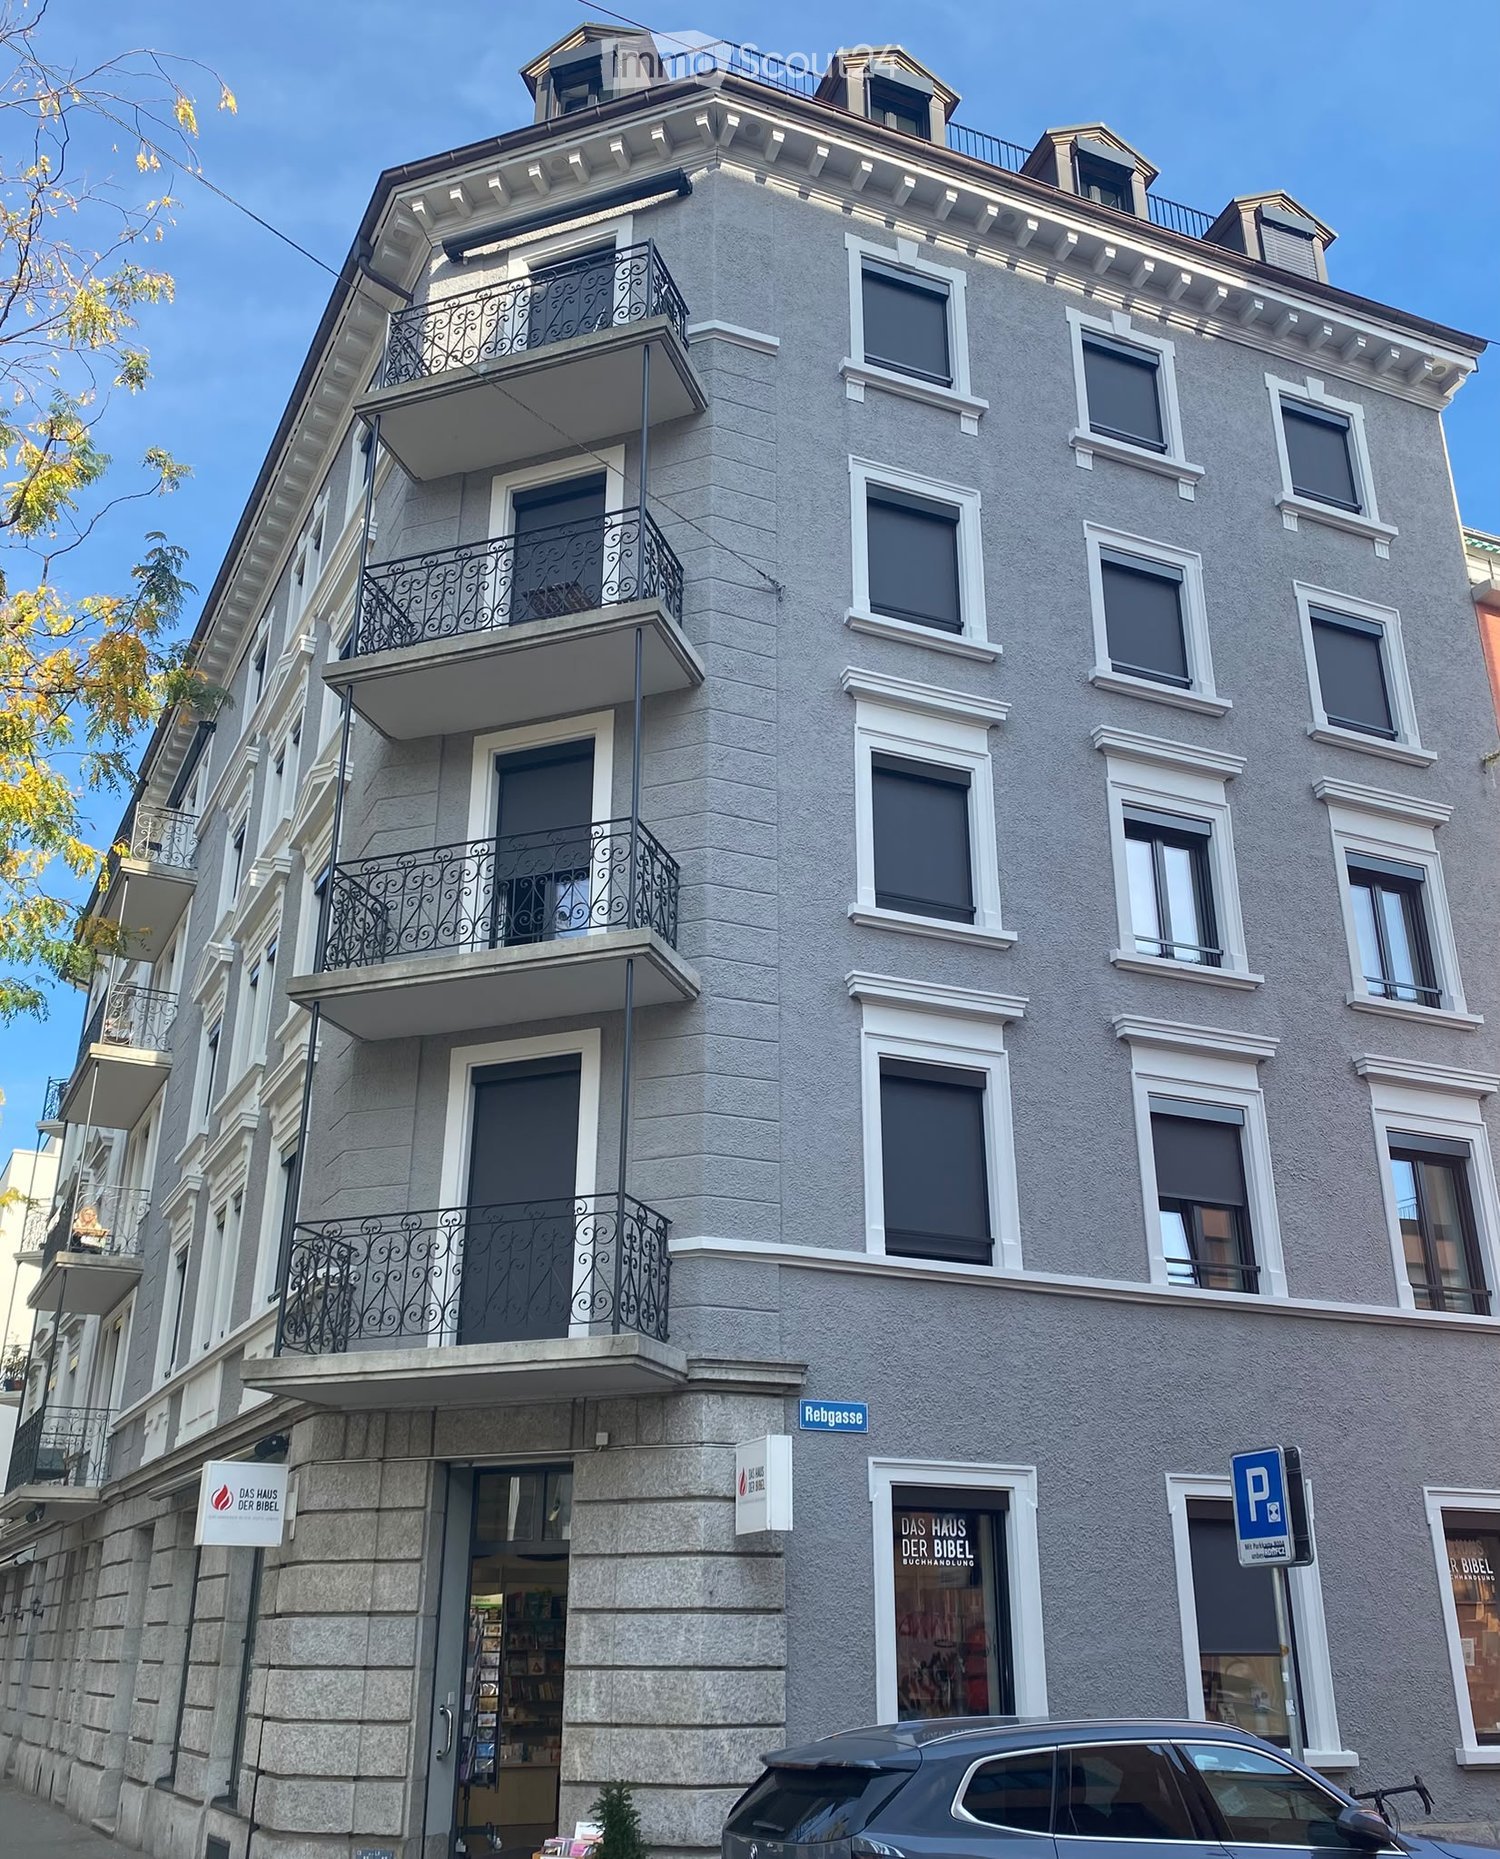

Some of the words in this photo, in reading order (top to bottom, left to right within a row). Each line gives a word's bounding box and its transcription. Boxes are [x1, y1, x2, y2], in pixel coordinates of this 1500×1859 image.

[805, 1406, 863, 1426] Rebgasse
[239, 1488, 255, 1499] DAS
[256, 1489, 278, 1500] HAUS
[1245, 1466, 1270, 1522] P
[238, 1500, 254, 1511] DER
[256, 1501, 280, 1512] BIBEL
[901, 1517, 926, 1536] DAS
[932, 1518, 967, 1538] HAUS
[902, 1539, 928, 1557] DER
[934, 1539, 974, 1559] BIBEL
[902, 1558, 975, 1567] BUCHHANDLUNG
[1461, 1557, 1494, 1574] BIBEL
